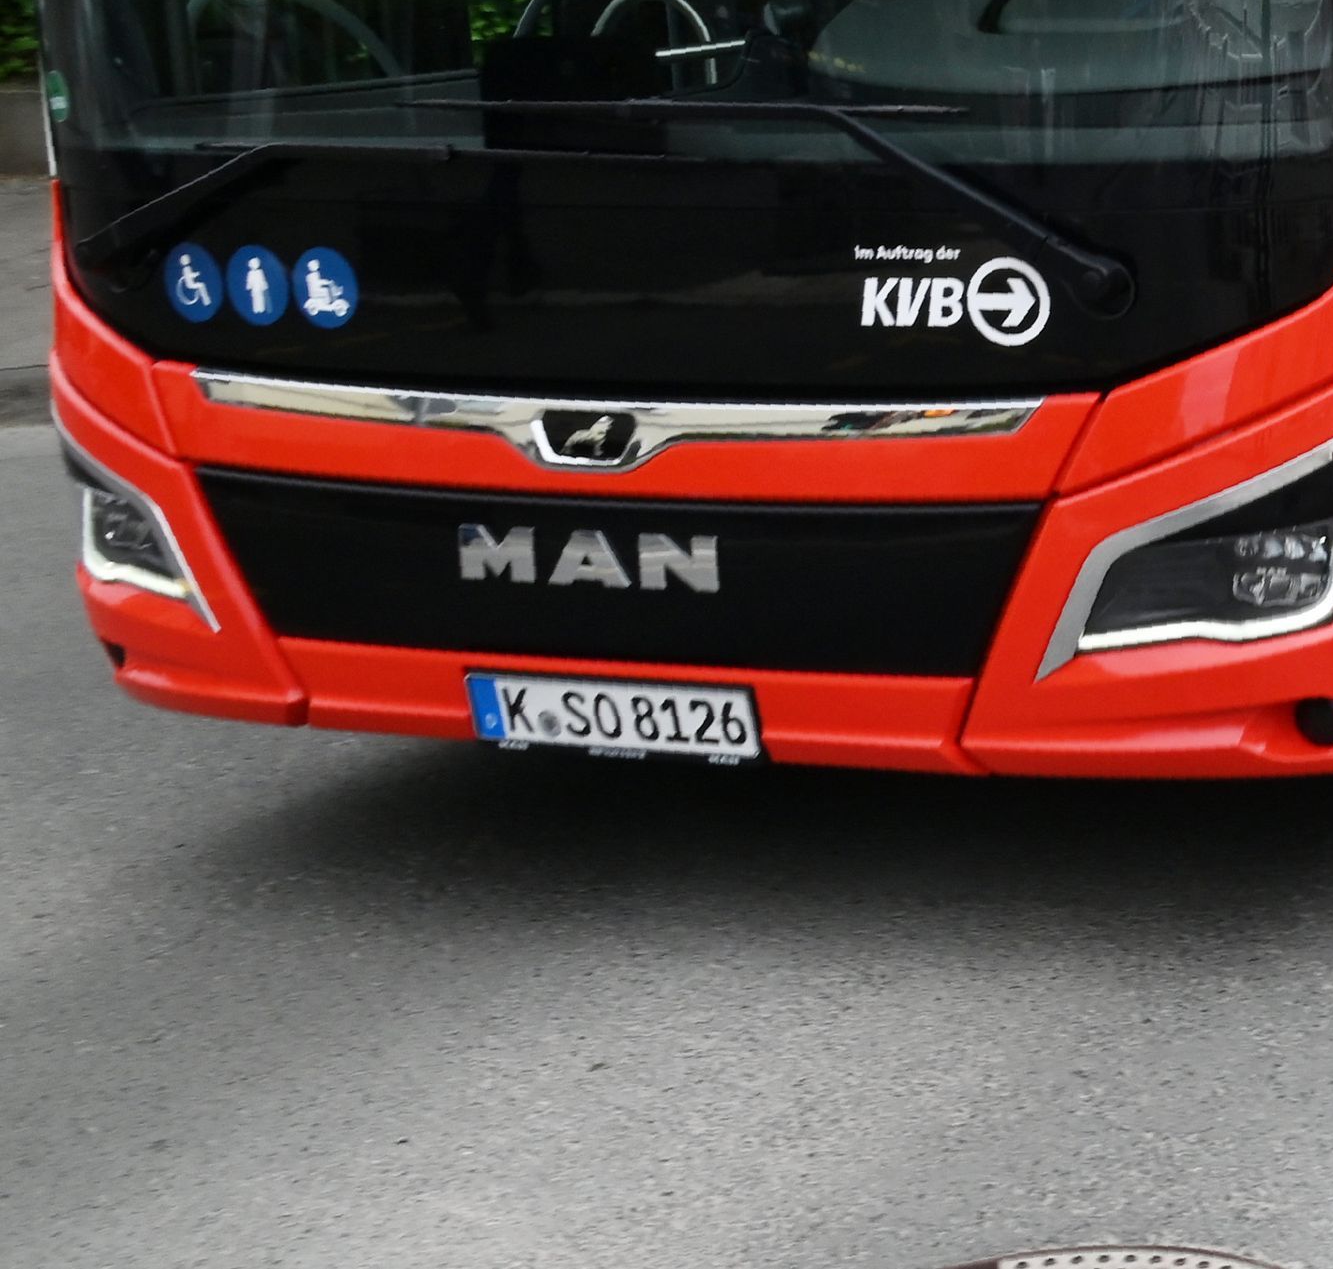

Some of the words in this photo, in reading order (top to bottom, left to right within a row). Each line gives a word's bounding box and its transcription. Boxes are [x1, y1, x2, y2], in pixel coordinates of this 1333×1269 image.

[876, 244, 934, 264] Auftrag
[935, 244, 962, 261] der
[860, 276, 965, 328] KVB
[458, 523, 721, 594] MAN
